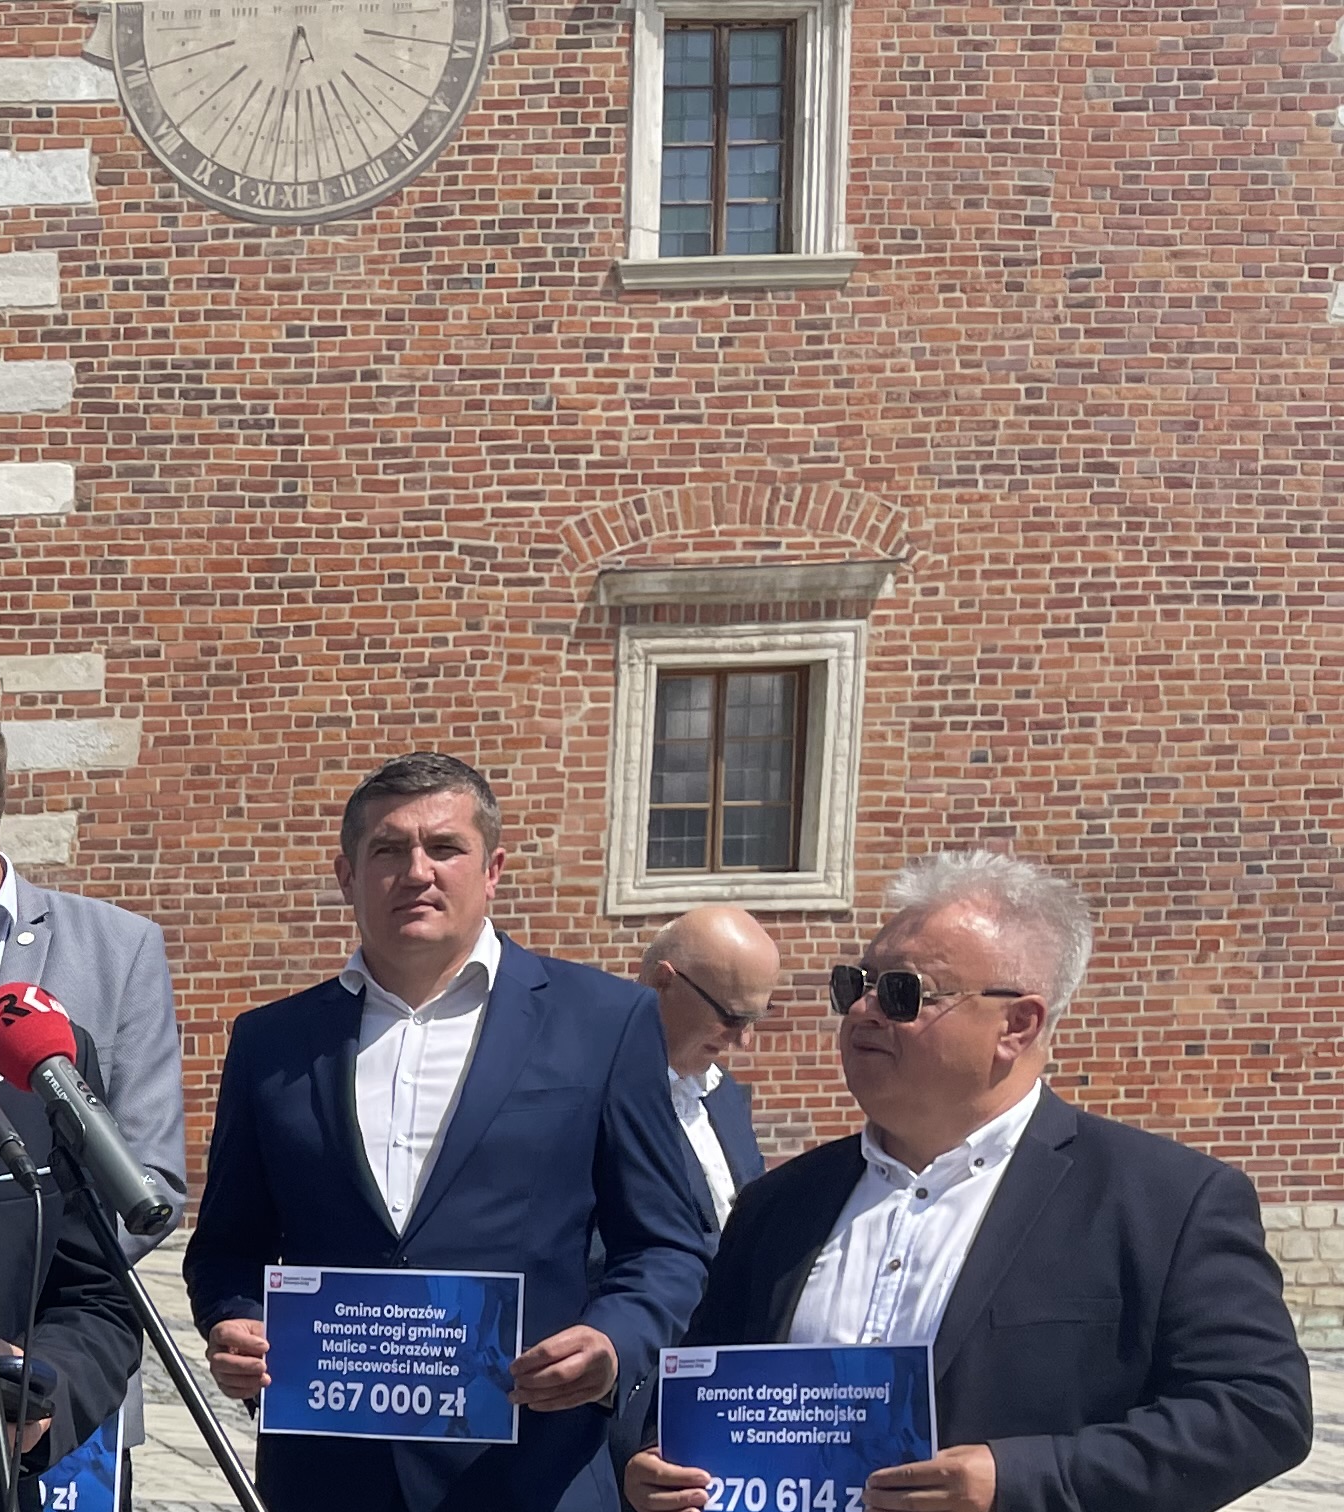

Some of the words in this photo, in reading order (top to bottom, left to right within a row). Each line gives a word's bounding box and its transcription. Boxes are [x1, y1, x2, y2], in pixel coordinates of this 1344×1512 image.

[335, 1303, 380, 1318] Gmina
[384, 1304, 446, 1320] Obrazów
[314, 1320, 367, 1335] Remont
[370, 1322, 405, 1339] drogi
[408, 1324, 466, 1343] gminnej
[323, 1339, 366, 1354] Malice
[380, 1341, 441, 1357] Obrazów
[444, 1347, 456, 1358] w
[318, 1357, 410, 1375] miejscowości
[413, 1360, 459, 1376] Malice
[308, 1380, 363, 1412] 367
[370, 1383, 432, 1416] 000
[439, 1387, 466, 1416] zł
[697, 1386, 754, 1402] Remont
[757, 1383, 797, 1404] drogi
[800, 1382, 890, 1404] powiatowej
[728, 1406, 765, 1422] ulica
[768, 1406, 867, 1426] Zawichojska
[731, 1430, 746, 1444] w
[747, 1427, 851, 1444] Sandomierzu
[53, 1481, 78, 1510] zł
[704, 1477, 766, 1512] 270
